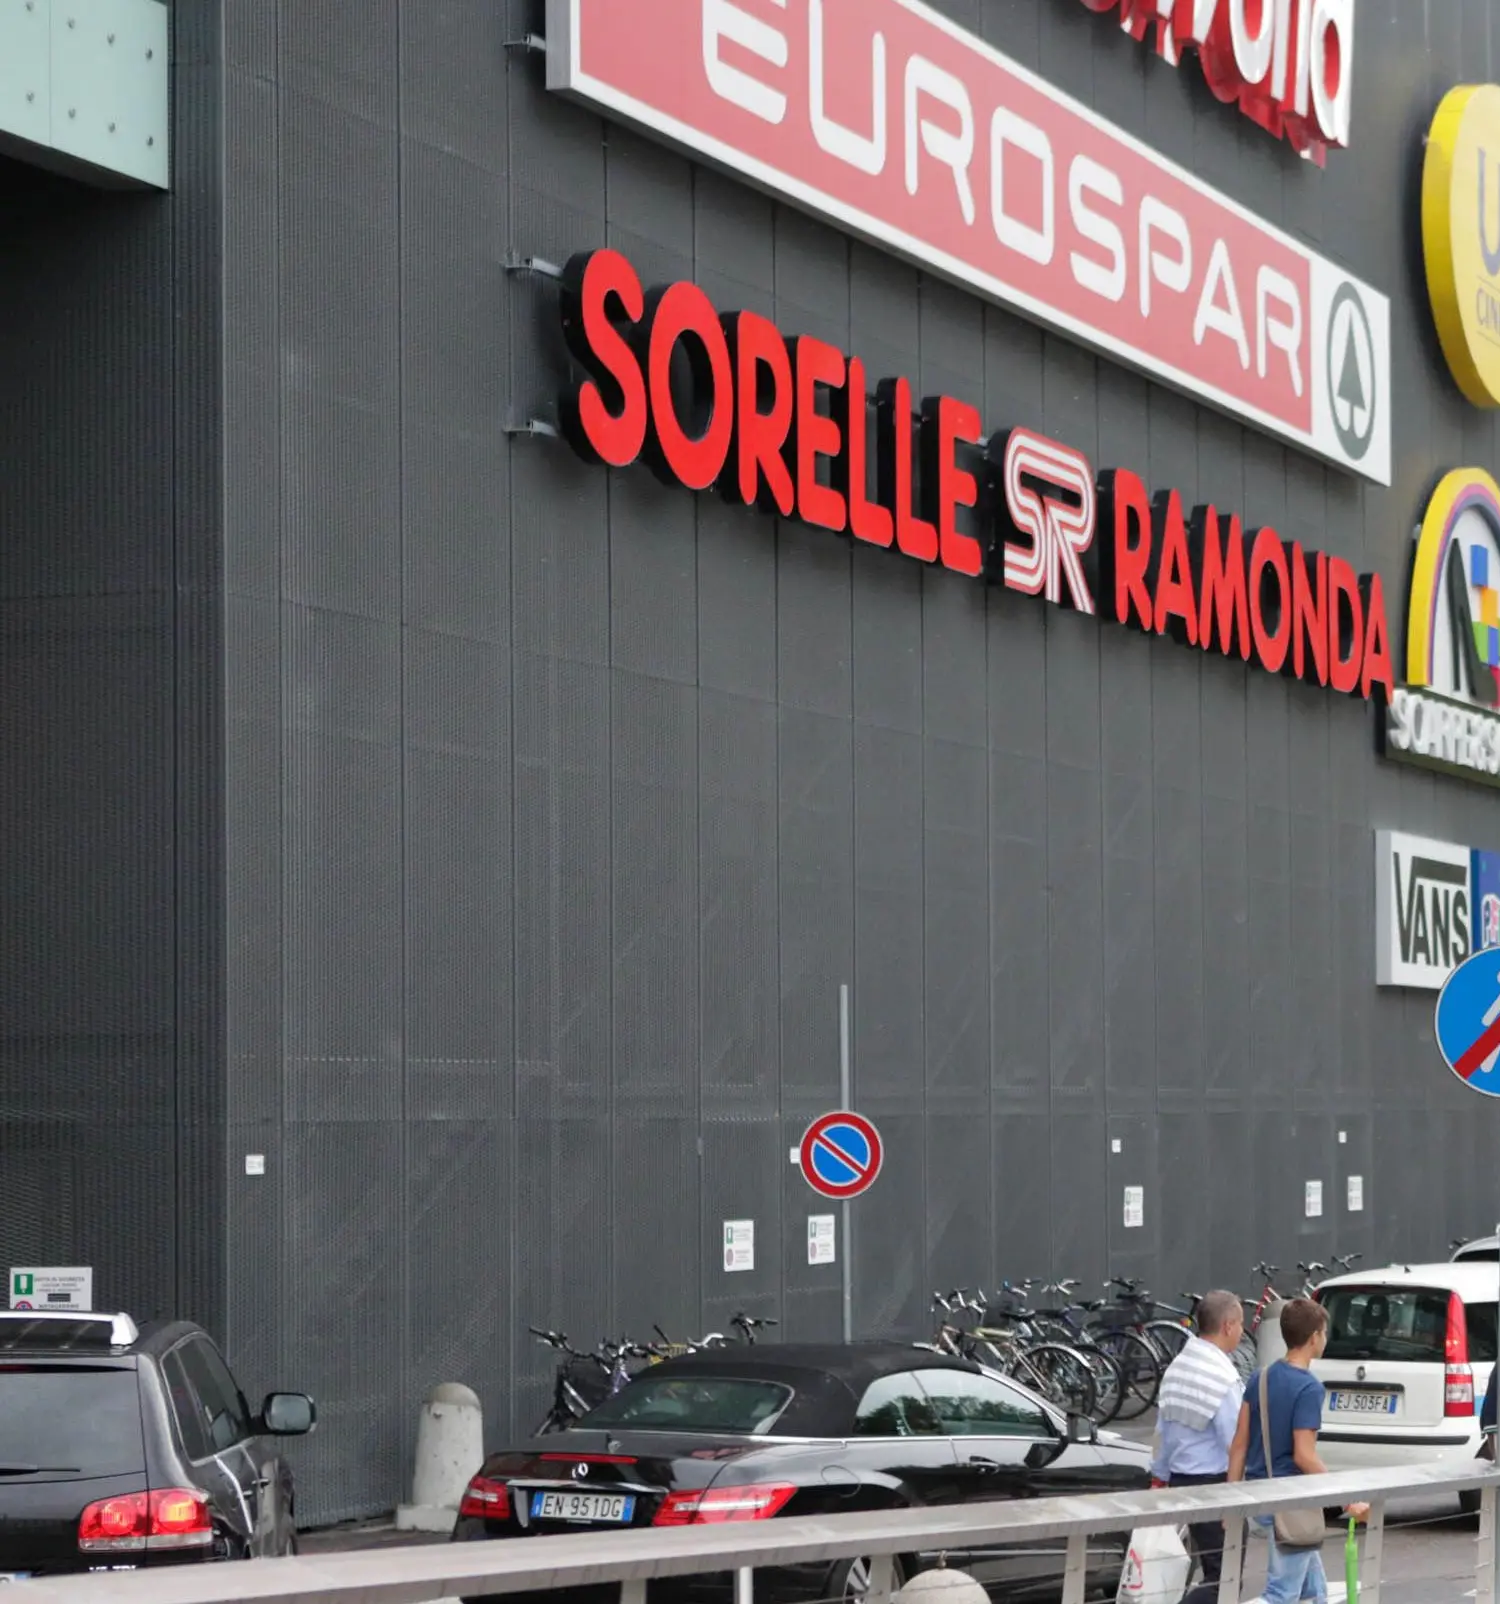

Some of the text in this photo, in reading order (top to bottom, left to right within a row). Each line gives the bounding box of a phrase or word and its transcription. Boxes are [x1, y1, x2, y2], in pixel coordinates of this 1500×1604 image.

[702, 0, 1304, 398] EUROSPAR
[578, 249, 982, 577] SORELLE
[1004, 426, 1096, 615] SR
[1115, 468, 1393, 702] RAMONDA
[1393, 851, 1470, 968] VANS
[543, 1495, 622, 1518] EN 951DG
